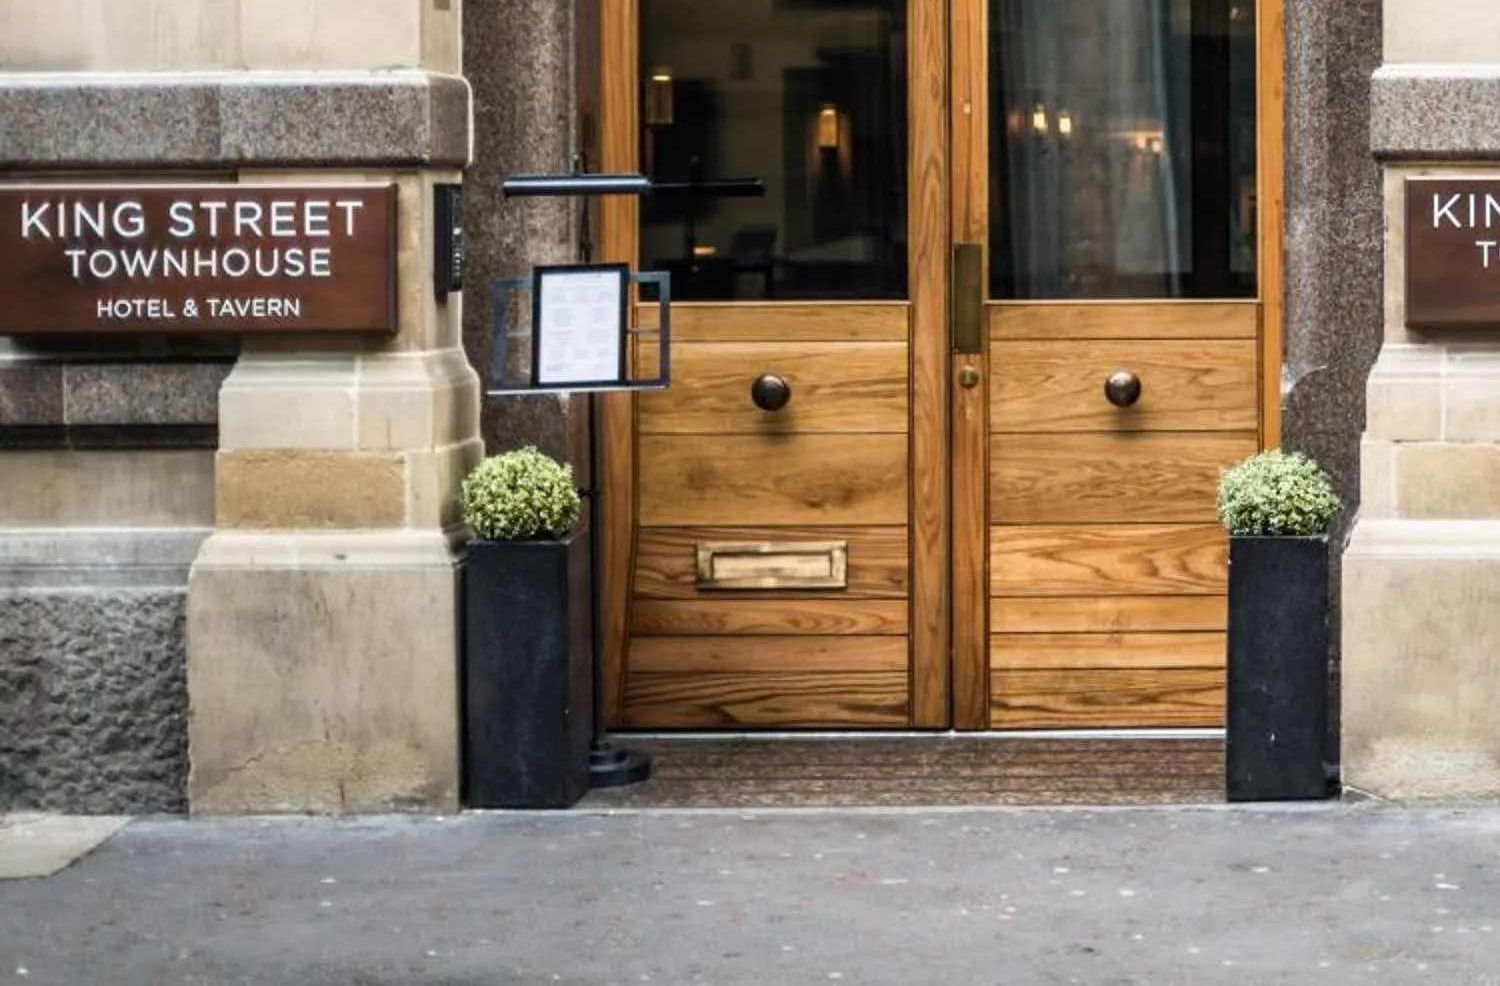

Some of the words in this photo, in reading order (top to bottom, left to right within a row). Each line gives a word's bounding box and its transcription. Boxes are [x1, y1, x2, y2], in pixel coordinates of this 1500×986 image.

[22, 202, 144, 237] KING
[169, 201, 363, 236] STREET
[65, 248, 330, 278] TOWNHOUSE
[98, 299, 175, 317] HOTEL
[183, 299, 198, 317] &
[206, 298, 299, 316] TAVERN
